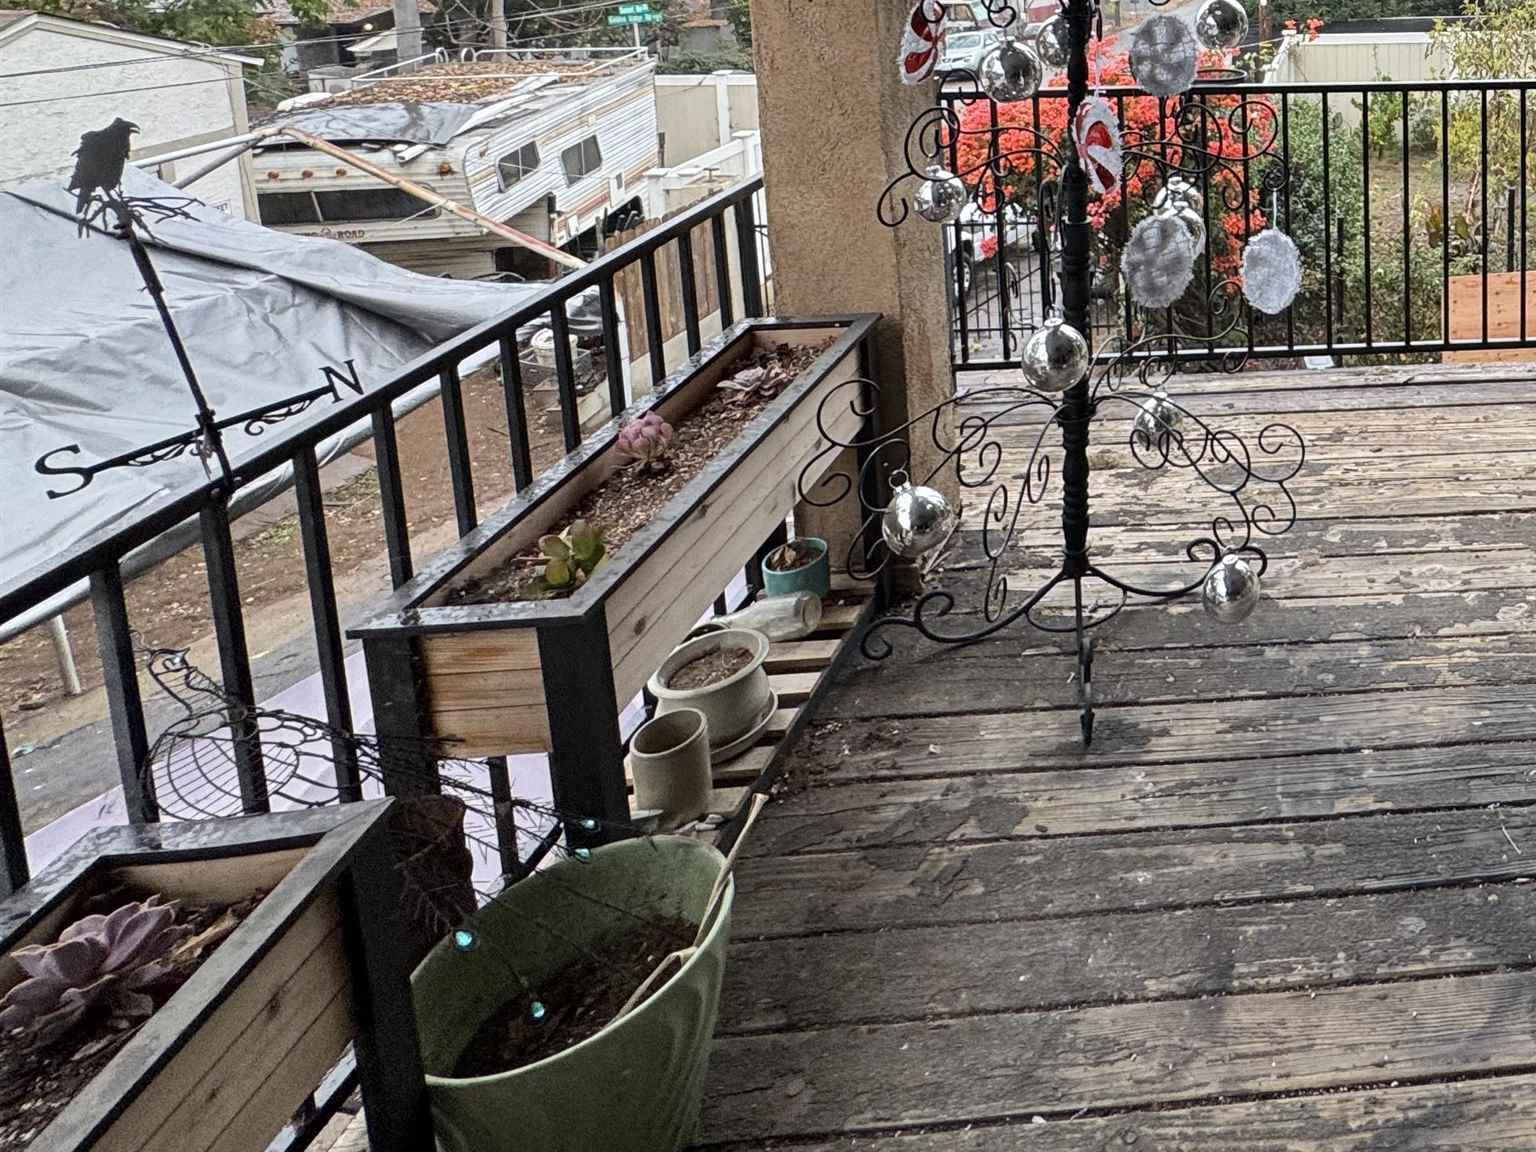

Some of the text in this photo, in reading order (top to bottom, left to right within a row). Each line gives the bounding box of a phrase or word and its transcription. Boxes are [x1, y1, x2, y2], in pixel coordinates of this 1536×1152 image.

[336, 229, 366, 241] ROAD
[318, 358, 365, 404] N
[34, 443, 95, 500] S
